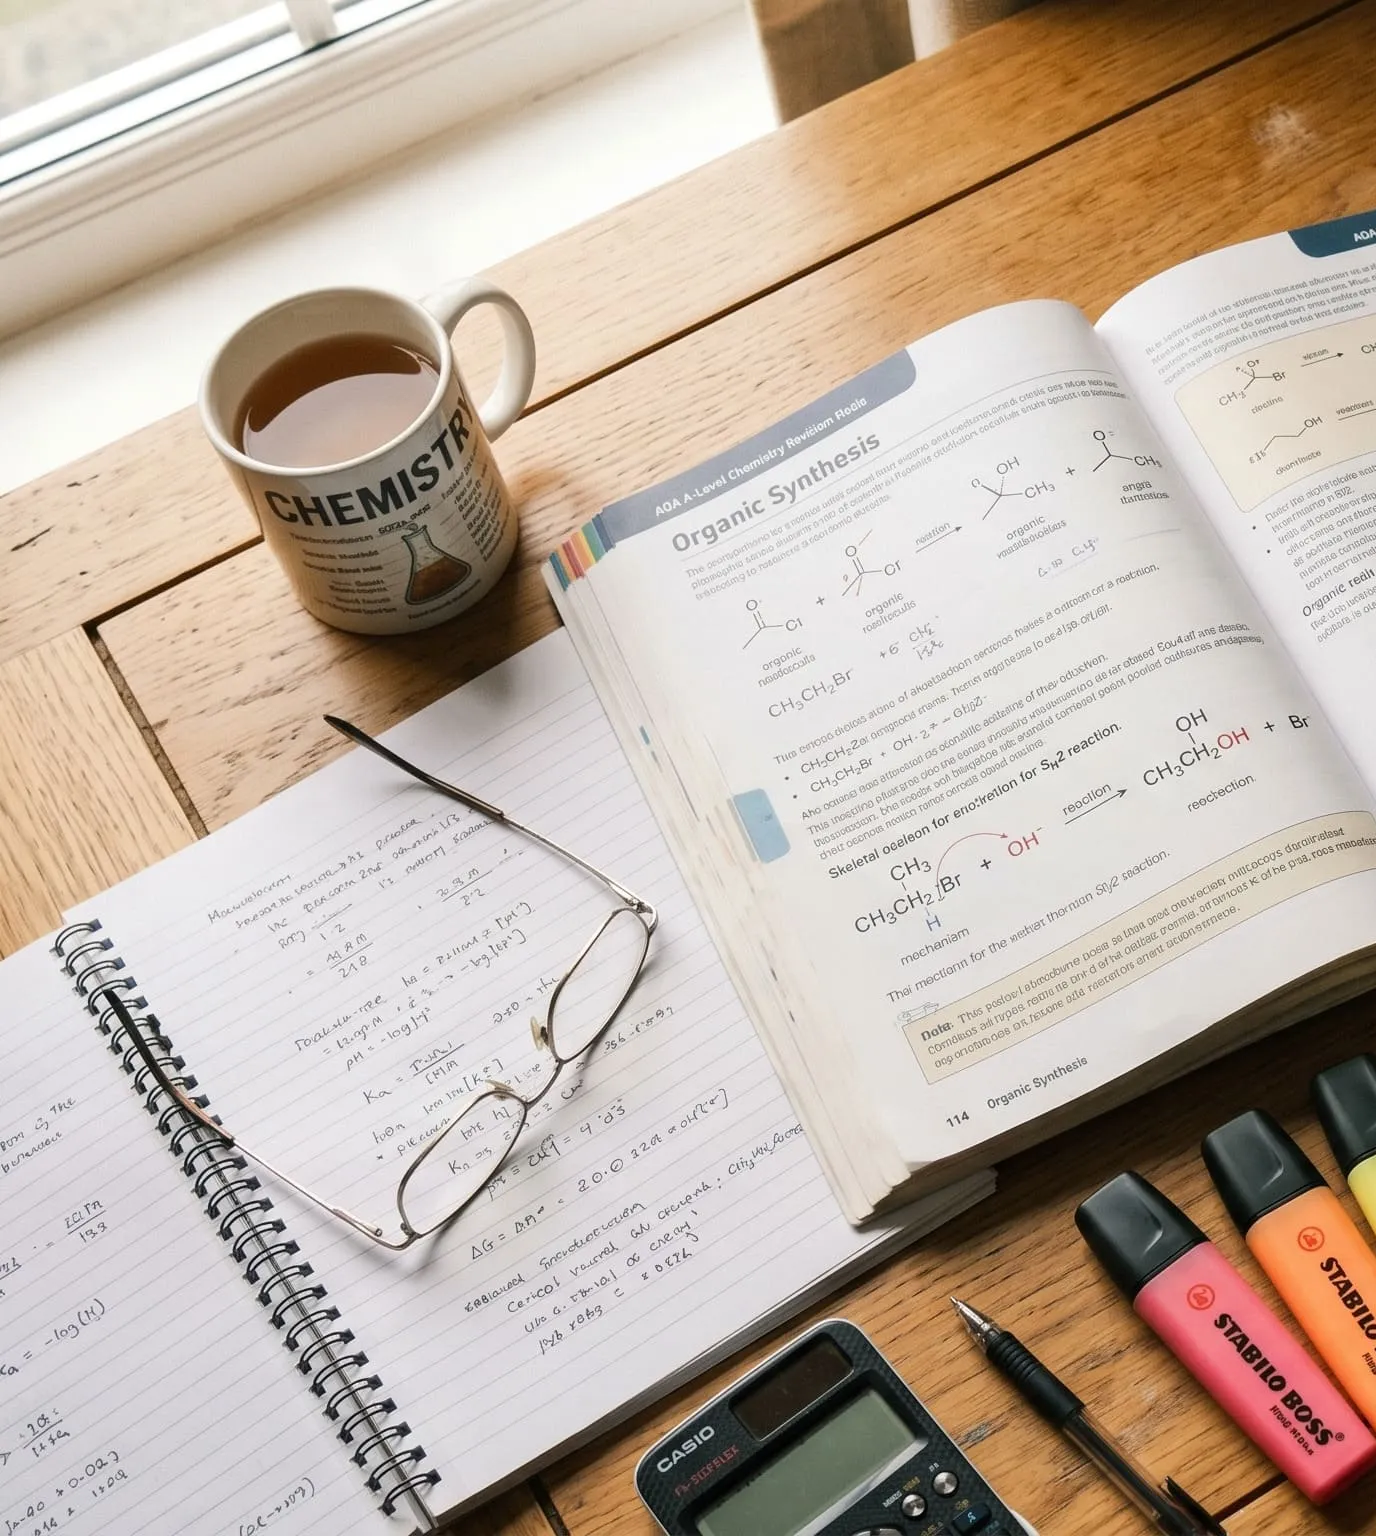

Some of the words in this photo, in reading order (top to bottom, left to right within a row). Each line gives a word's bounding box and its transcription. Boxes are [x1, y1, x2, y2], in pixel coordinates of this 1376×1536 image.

[1303, 415, 1324, 430] OH
[263, 393, 475, 528] CHEMISTRY
[996, 456, 1021, 476] OH
[671, 495, 766, 554] Organic
[767, 430, 881, 506] Synthesis
[1174, 708, 1209, 733] OH
[828, 845, 881, 880] Skeletal
[931, 812, 950, 832] for
[1019, 766, 1038, 783] for
[1067, 722, 1123, 757] reaction.
[889, 856, 933, 883] CH3
[925, 914, 942, 932] H
[946, 1110, 970, 1128] 114
[986, 1082, 1032, 1110] Organic
[1213, 1311, 1288, 1393] STABILO
[1279, 1388, 1335, 1447] BOSS
[656, 1424, 716, 1473] CASIO
